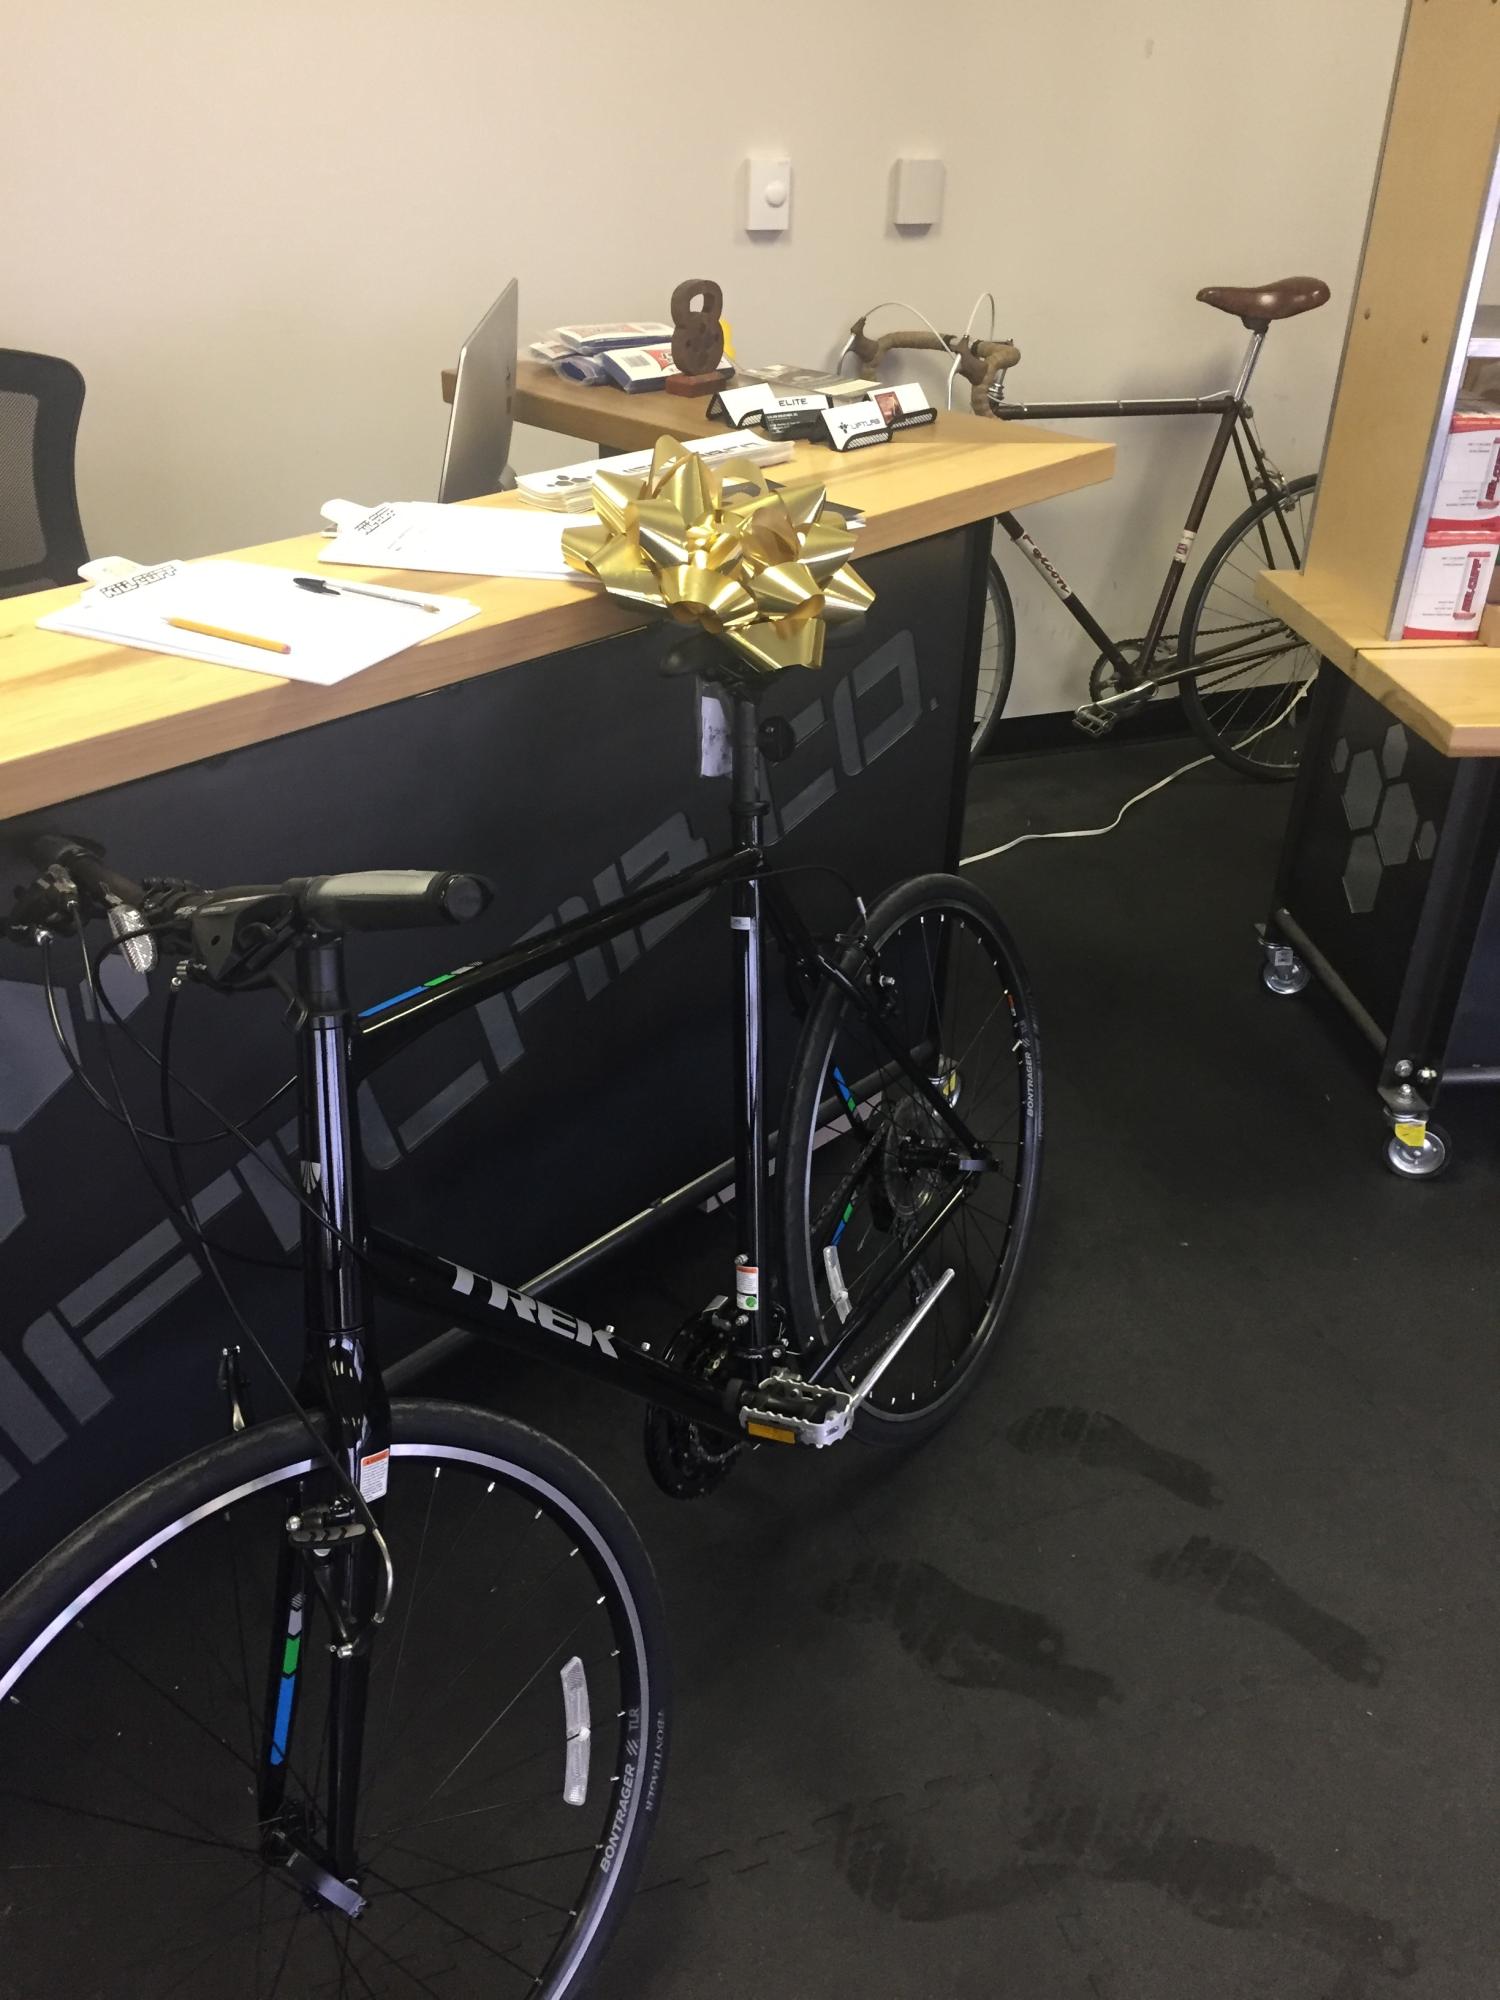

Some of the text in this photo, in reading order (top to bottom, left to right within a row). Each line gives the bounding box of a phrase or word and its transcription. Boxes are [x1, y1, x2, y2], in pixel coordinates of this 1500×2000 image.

[778, 397, 808, 407] ELITE
[1025, 1051, 1034, 1117] BONTRAGER
[437, 1256, 619, 1360] TREK
[600, 1707, 640, 1873] BONTRAGER TLR
